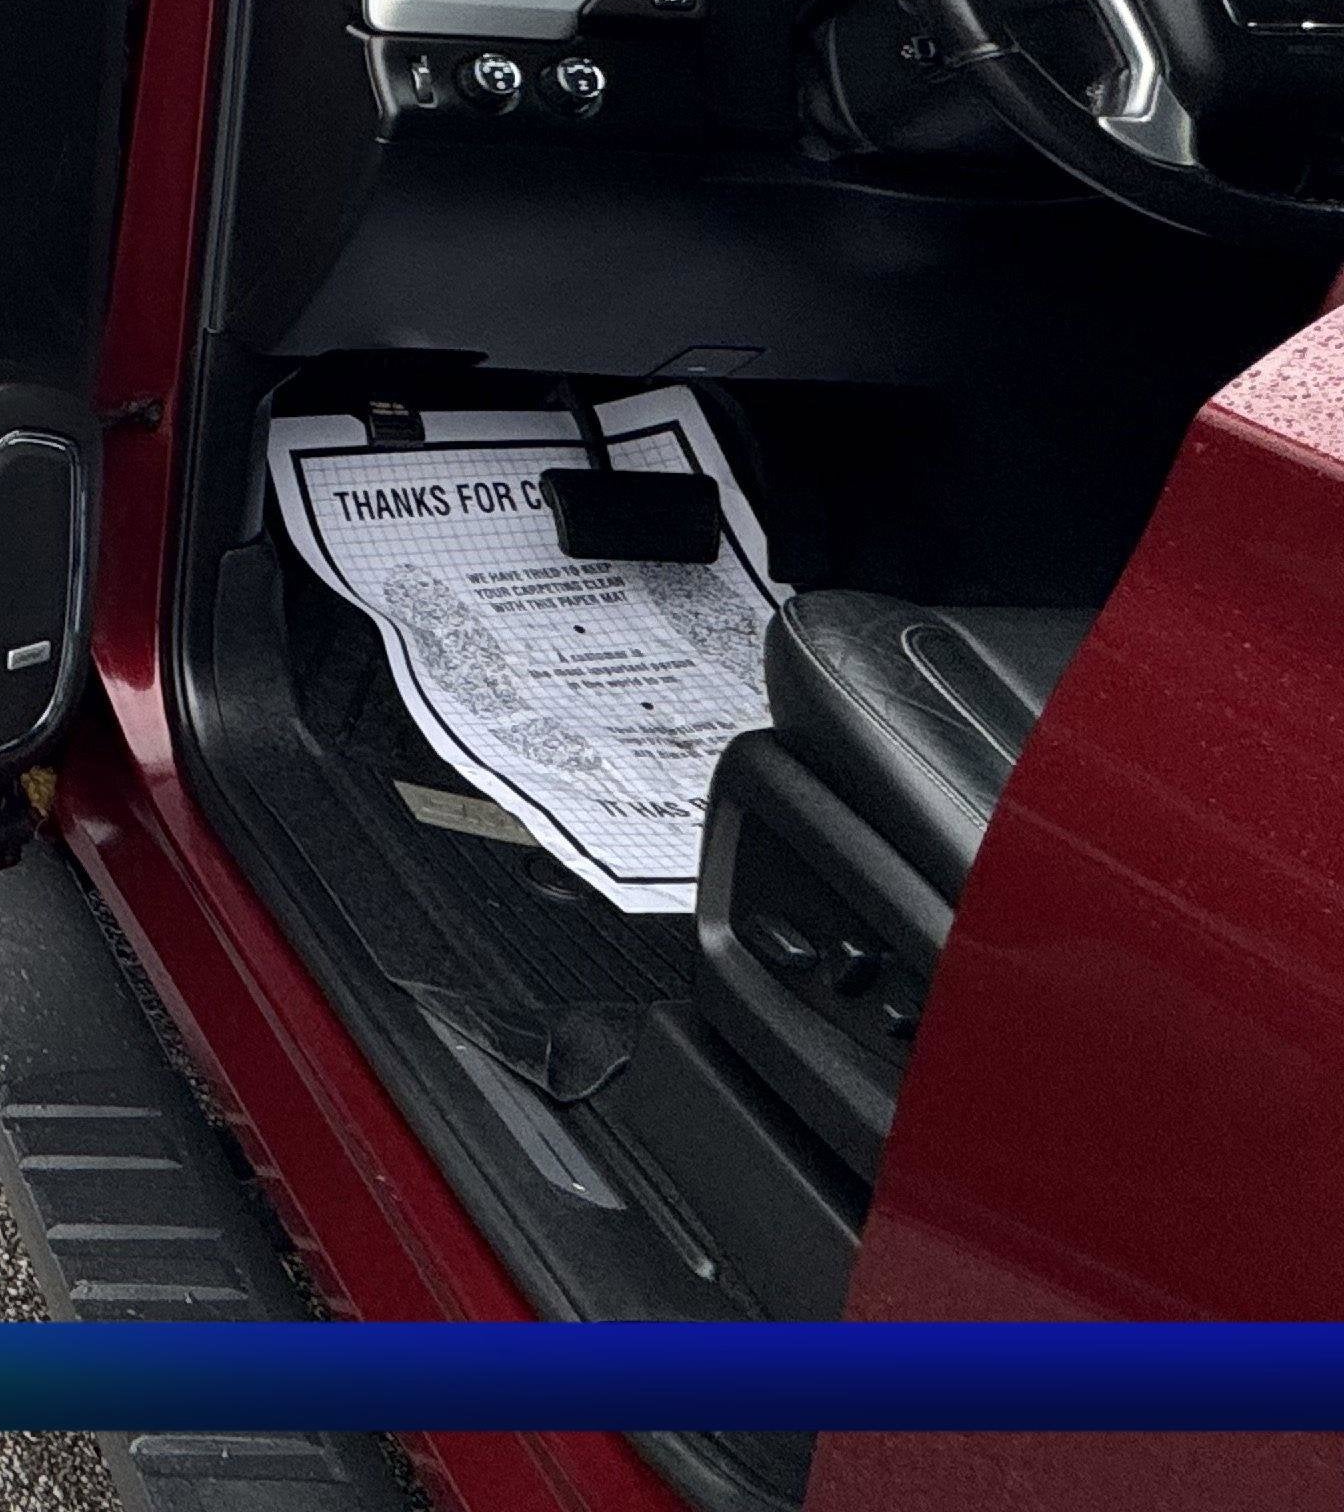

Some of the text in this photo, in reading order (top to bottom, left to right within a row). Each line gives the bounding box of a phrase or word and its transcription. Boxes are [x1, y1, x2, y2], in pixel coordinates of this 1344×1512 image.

[332, 484, 452, 522] THANKS
[455, 482, 518, 514] FOR
[475, 586, 512, 600] YOUR
[627, 801, 691, 818] HAS
